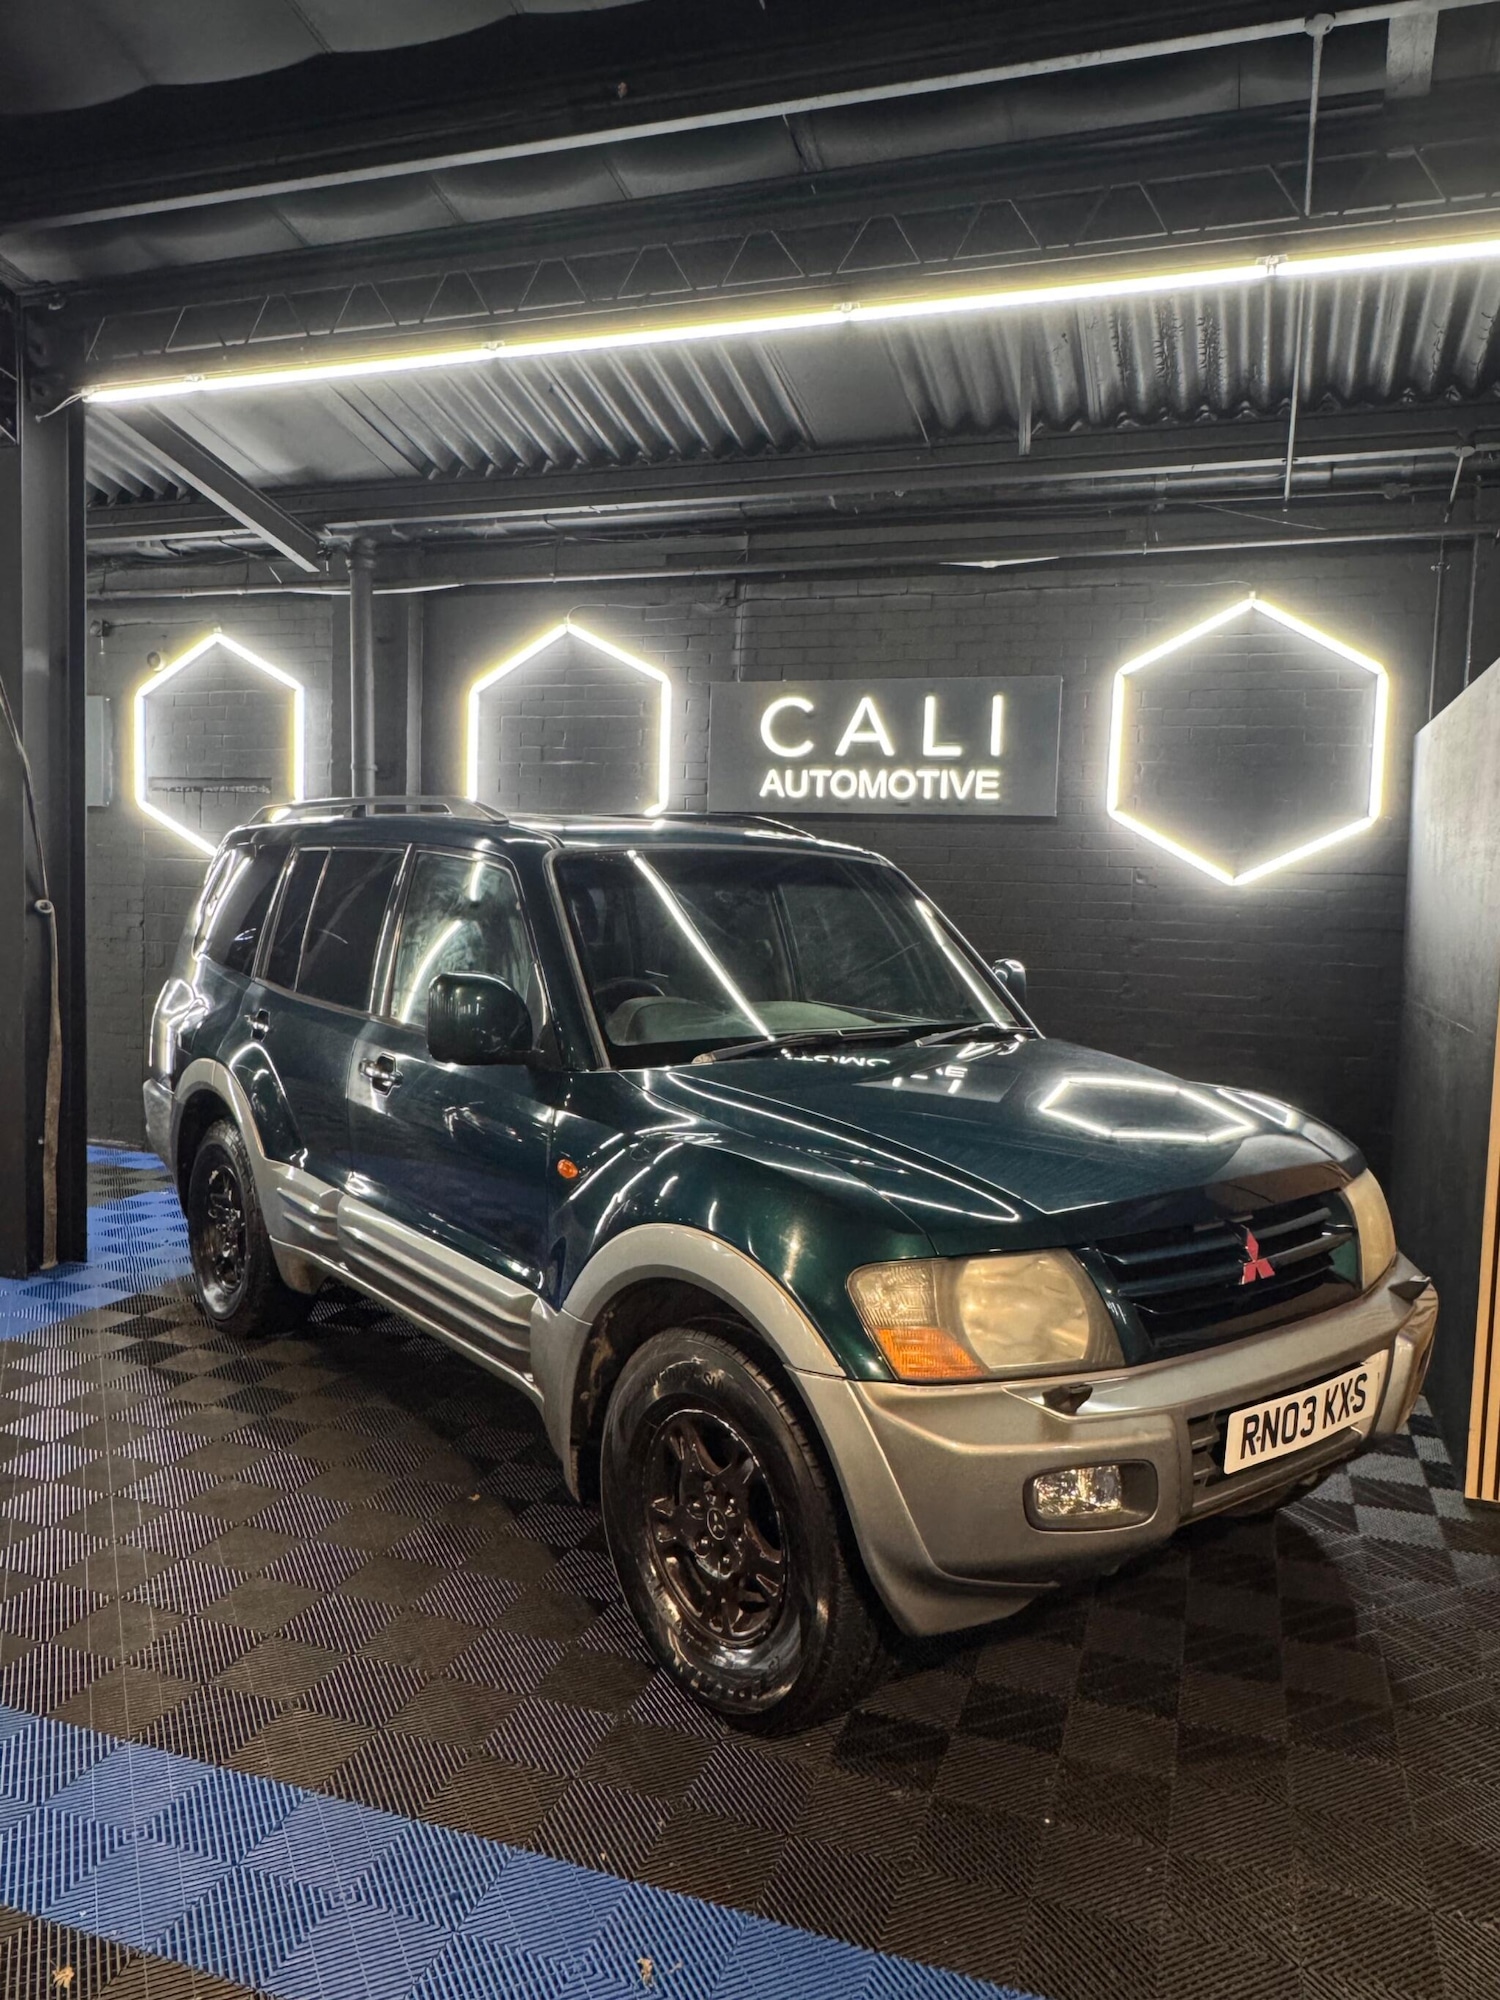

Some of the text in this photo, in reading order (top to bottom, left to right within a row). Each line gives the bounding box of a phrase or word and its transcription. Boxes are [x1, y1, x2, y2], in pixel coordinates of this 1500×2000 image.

[760, 694, 1004, 757] CALI
[759, 768, 1001, 800] AUTOMOTIVE
[1240, 1373, 1368, 1460] RN03 KXS
